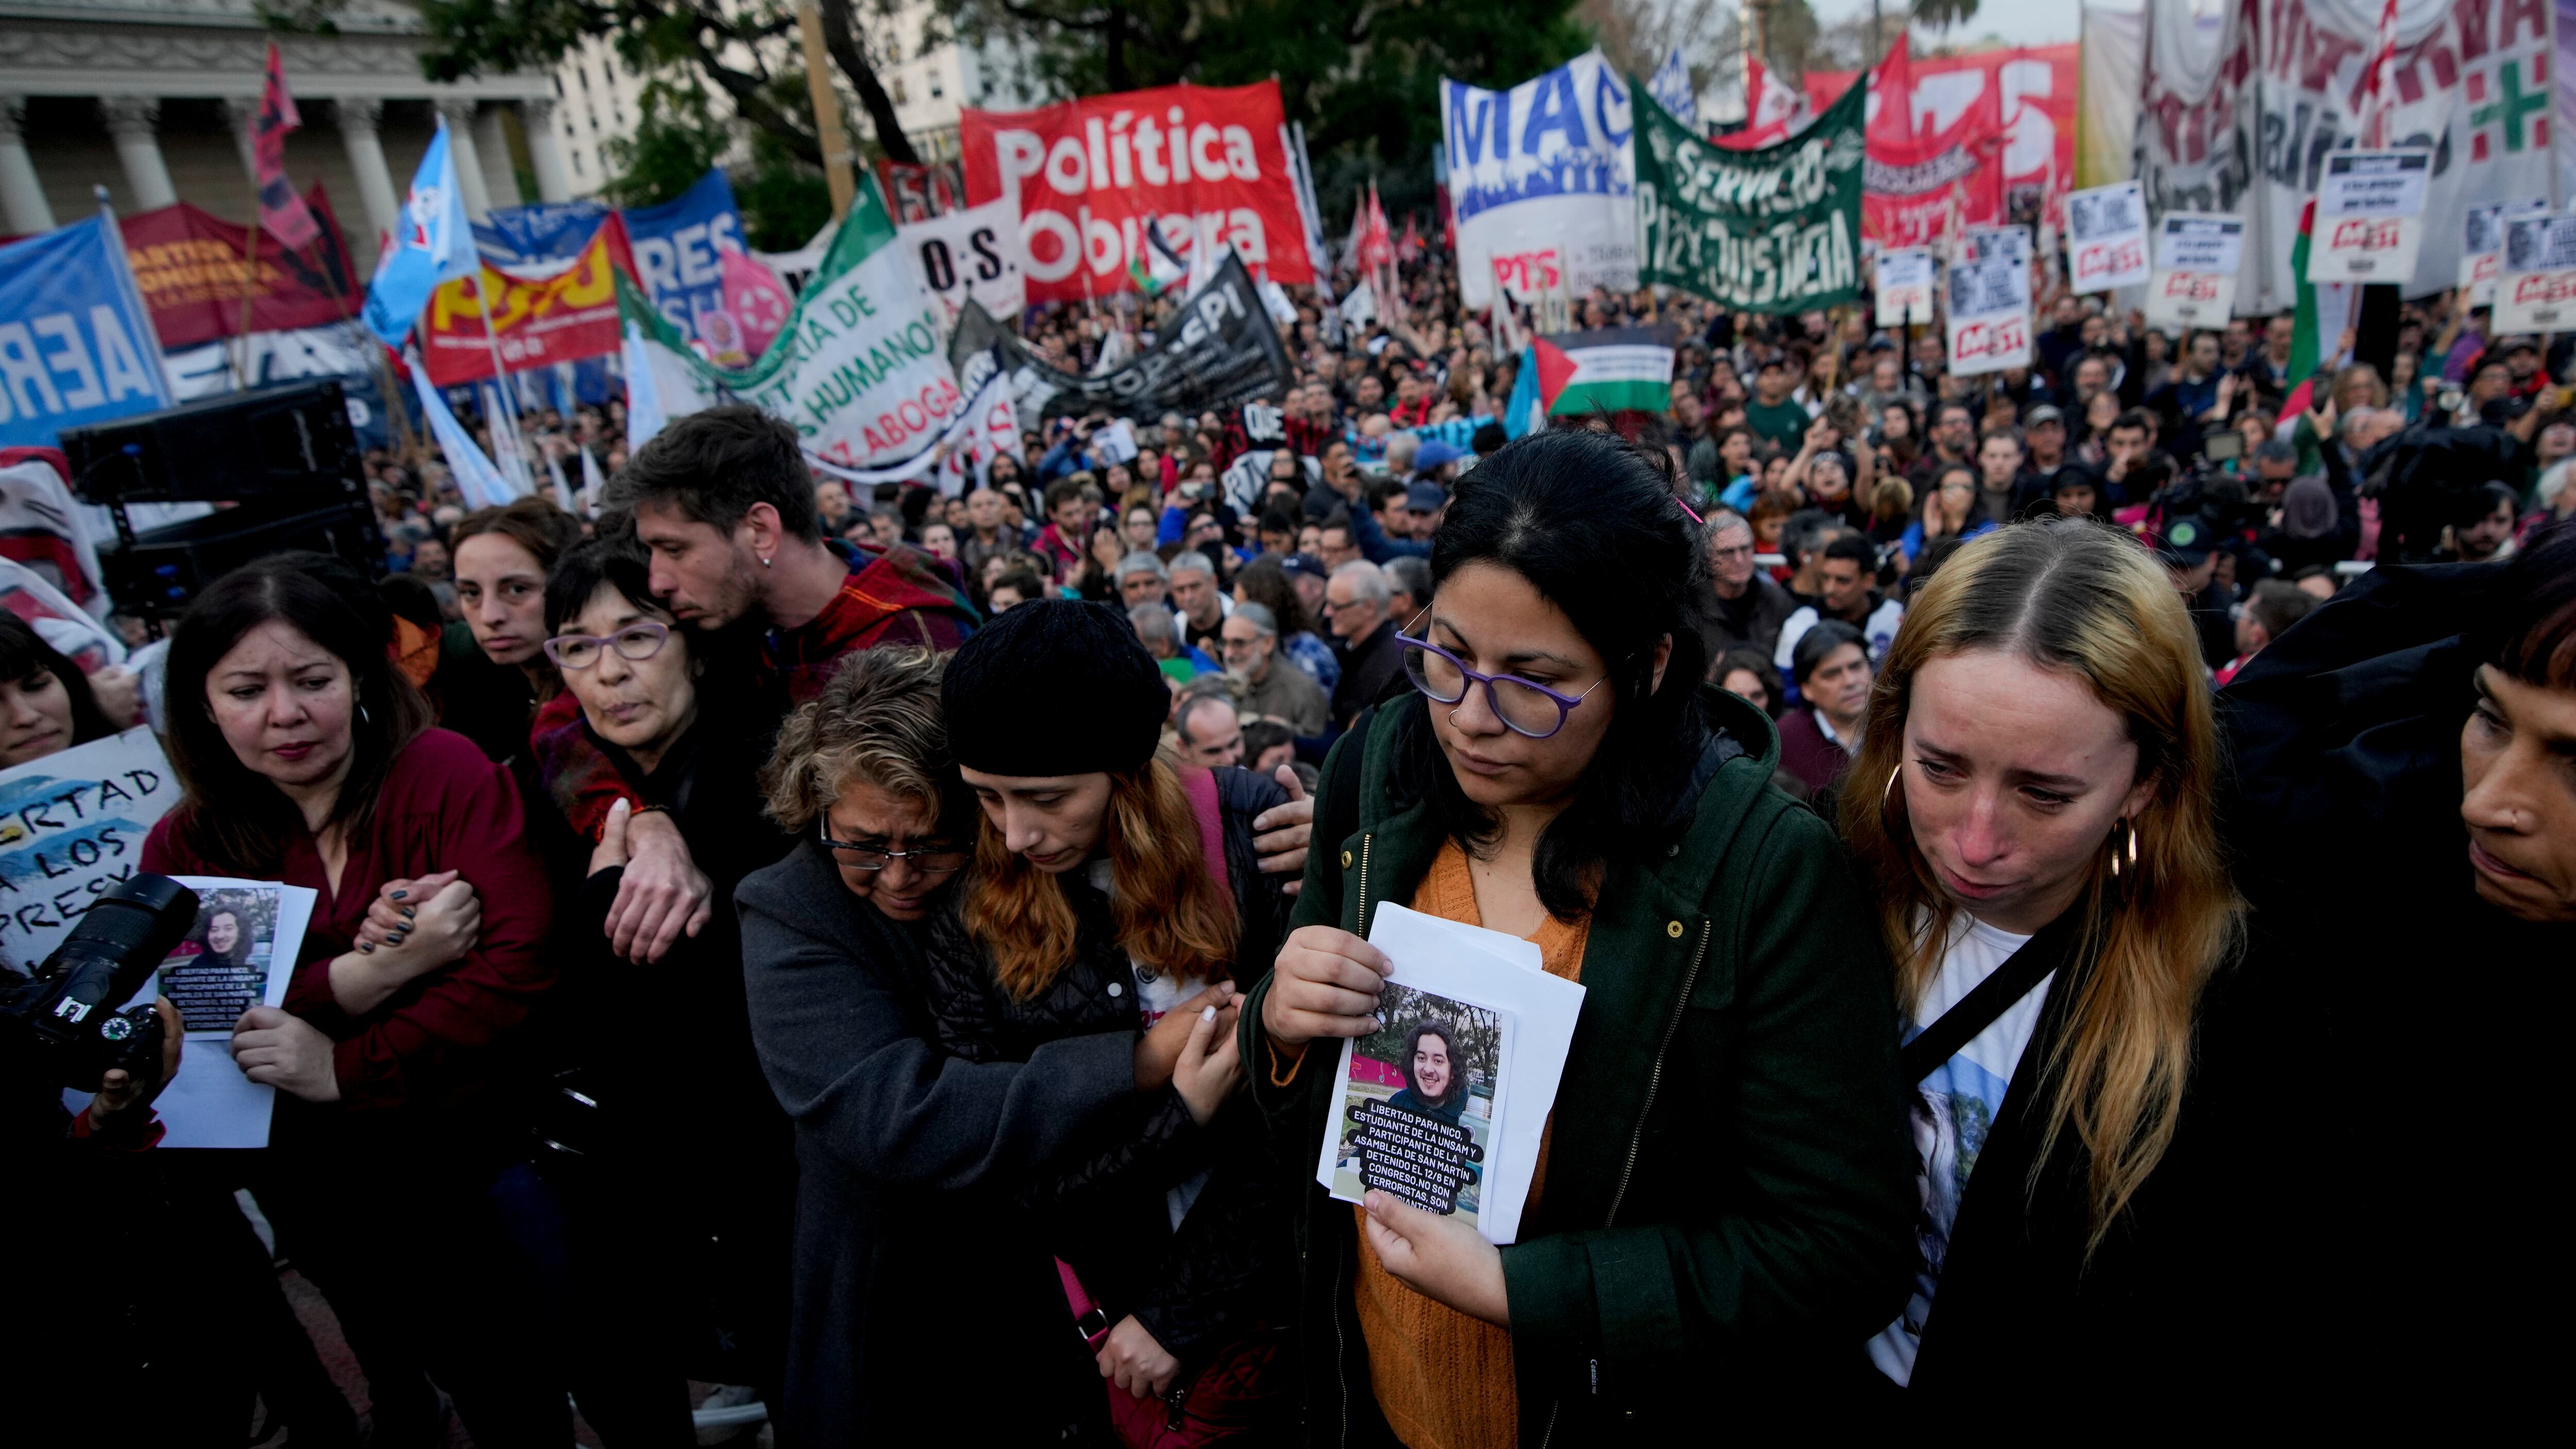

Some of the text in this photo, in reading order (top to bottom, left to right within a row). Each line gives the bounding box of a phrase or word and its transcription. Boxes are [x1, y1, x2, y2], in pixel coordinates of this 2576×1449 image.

[1867, 59, 2056, 178] TS
[994, 105, 1261, 200] Política
[1019, 206, 1268, 283] Obrera
[1494, 250, 1560, 294] PTS
[831, 284, 875, 329] DE
[35, 827, 125, 878] LOS
[1354, 1110, 1477, 1158] ESTUDIANTE DE LA UNSAM Y
[1370, 1103, 1463, 1141] LIBERTAD PARA NICO,
[1354, 1135, 1470, 1181] ASAMBLEA DE SAN MARTÍN
[1369, 1127, 1458, 1164] PARTICIPANTE DE LA
[1366, 1150, 1455, 1188] DETENIDO EL 12/6 EN
[1432, 1184, 1450, 1198] SON
[1368, 1174, 1448, 1210] TERRORISTAS, SON
